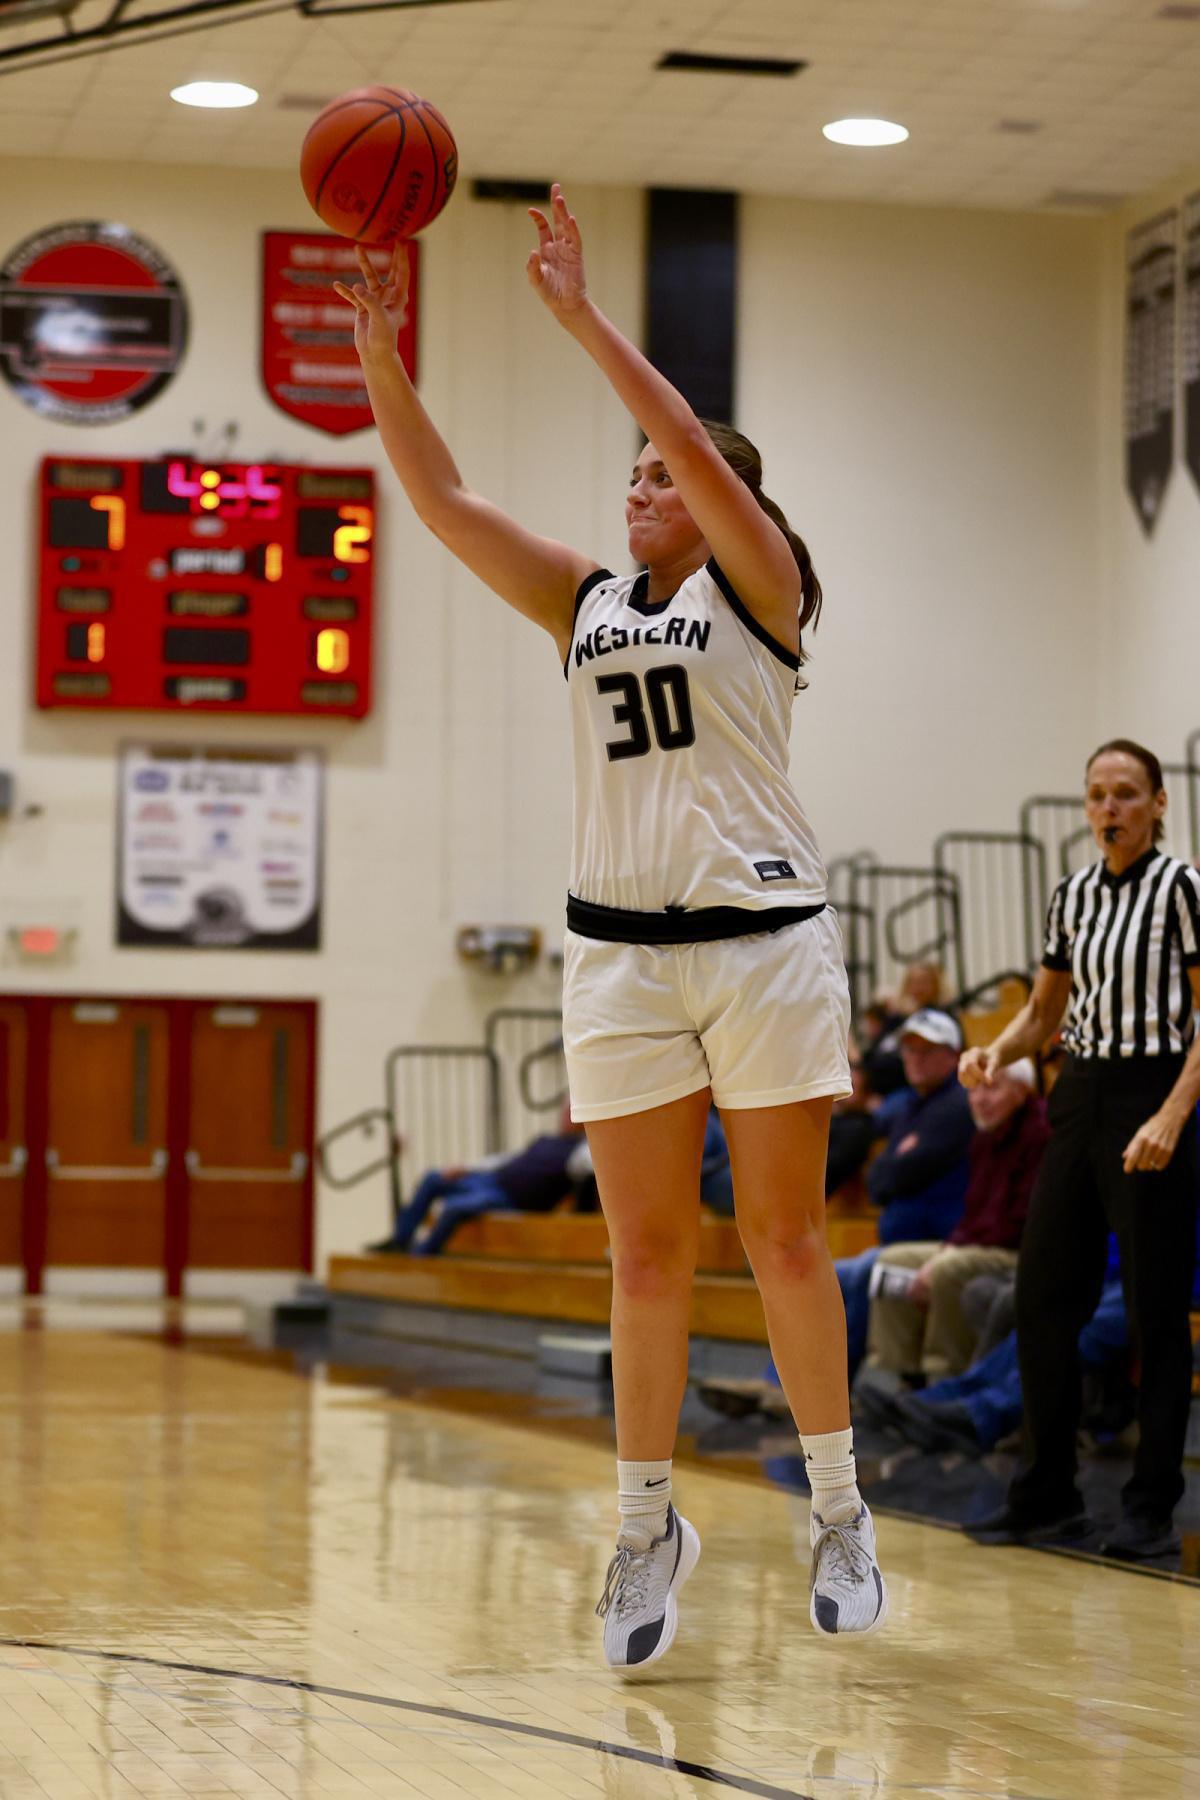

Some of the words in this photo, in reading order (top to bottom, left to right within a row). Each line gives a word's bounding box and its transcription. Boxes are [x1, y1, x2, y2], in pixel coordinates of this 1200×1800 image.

[90, 495, 126, 550] 7
[333, 505, 372, 563] 2
[265, 543, 283, 582] 1
[88, 623, 105, 662] 1
[574, 616, 712, 668] WESTERN
[595, 663, 696, 762] 30
